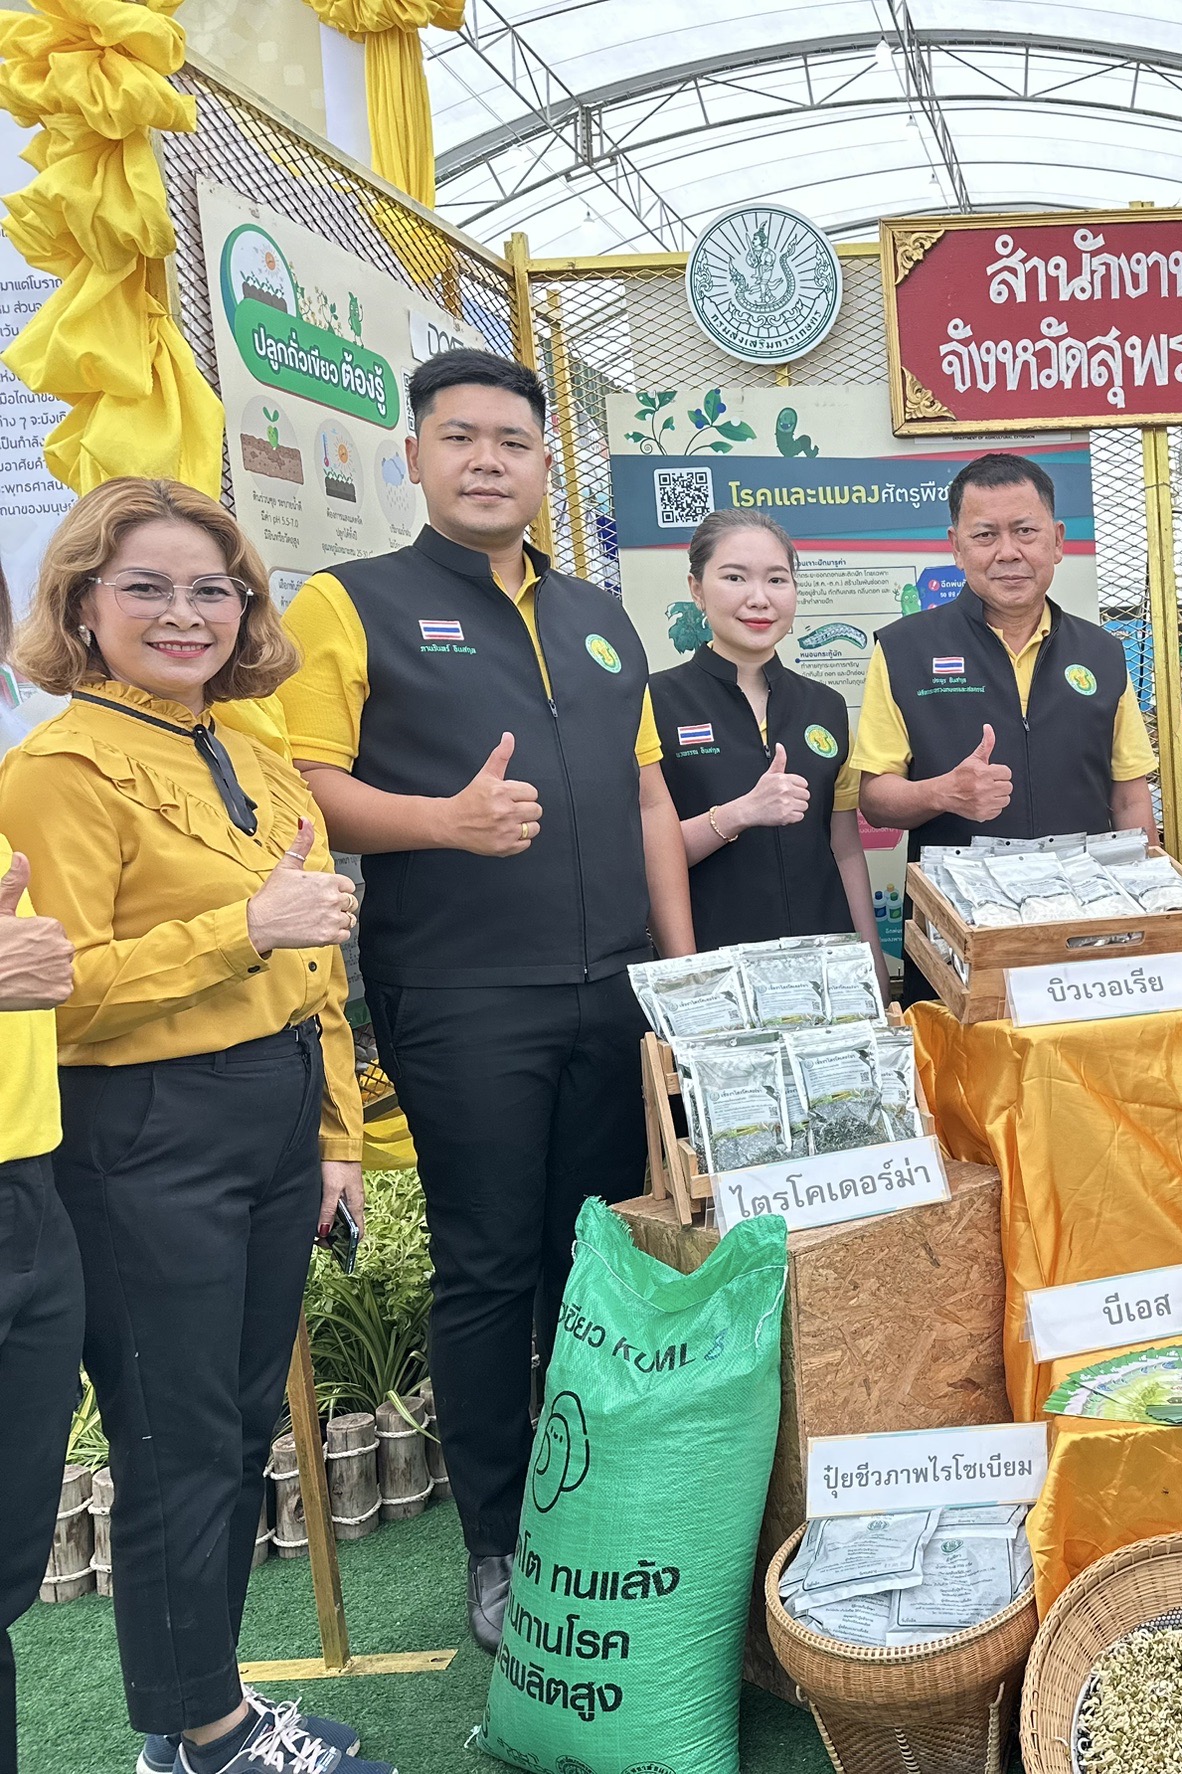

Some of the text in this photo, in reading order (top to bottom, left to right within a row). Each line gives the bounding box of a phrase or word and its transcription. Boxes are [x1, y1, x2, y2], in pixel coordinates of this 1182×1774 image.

[427, 321, 464, 355] DO
[252, 326, 387, 417] ปลูกถั่วเขียว ต้องรู้
[1047, 966, 1165, 1003] บิวเวอเรีย
[728, 1157, 932, 1219] ไตรโคเดอร์ม่า
[1102, 1291, 1173, 1327] บีเอส
[823, 1452, 1033, 1499] ปุ๋ยชีวภาพไรโซเบียม
[550, 1559, 681, 1601] ทนแล้ง
[497, 1642, 624, 1722] ลผลิตสูง
